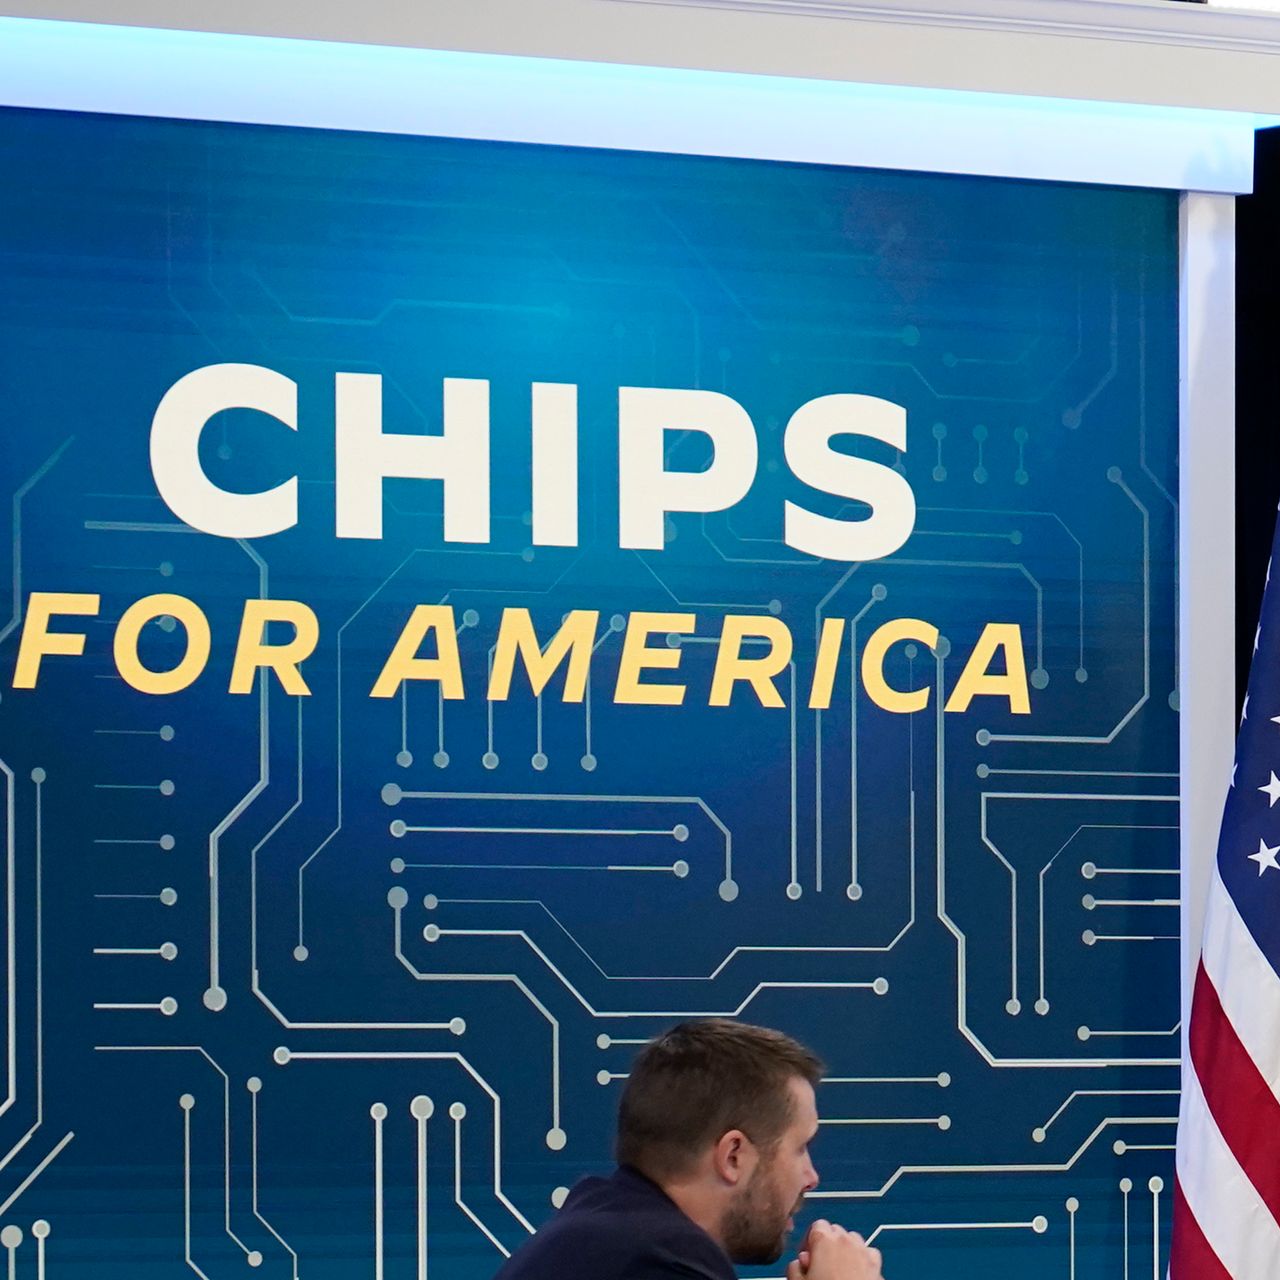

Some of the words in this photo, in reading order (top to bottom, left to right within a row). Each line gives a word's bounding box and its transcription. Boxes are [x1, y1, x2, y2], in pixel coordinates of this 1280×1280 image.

[150, 363, 916, 562] CHIPS
[12, 593, 320, 696] FOR
[370, 605, 1032, 714] AMERICA
